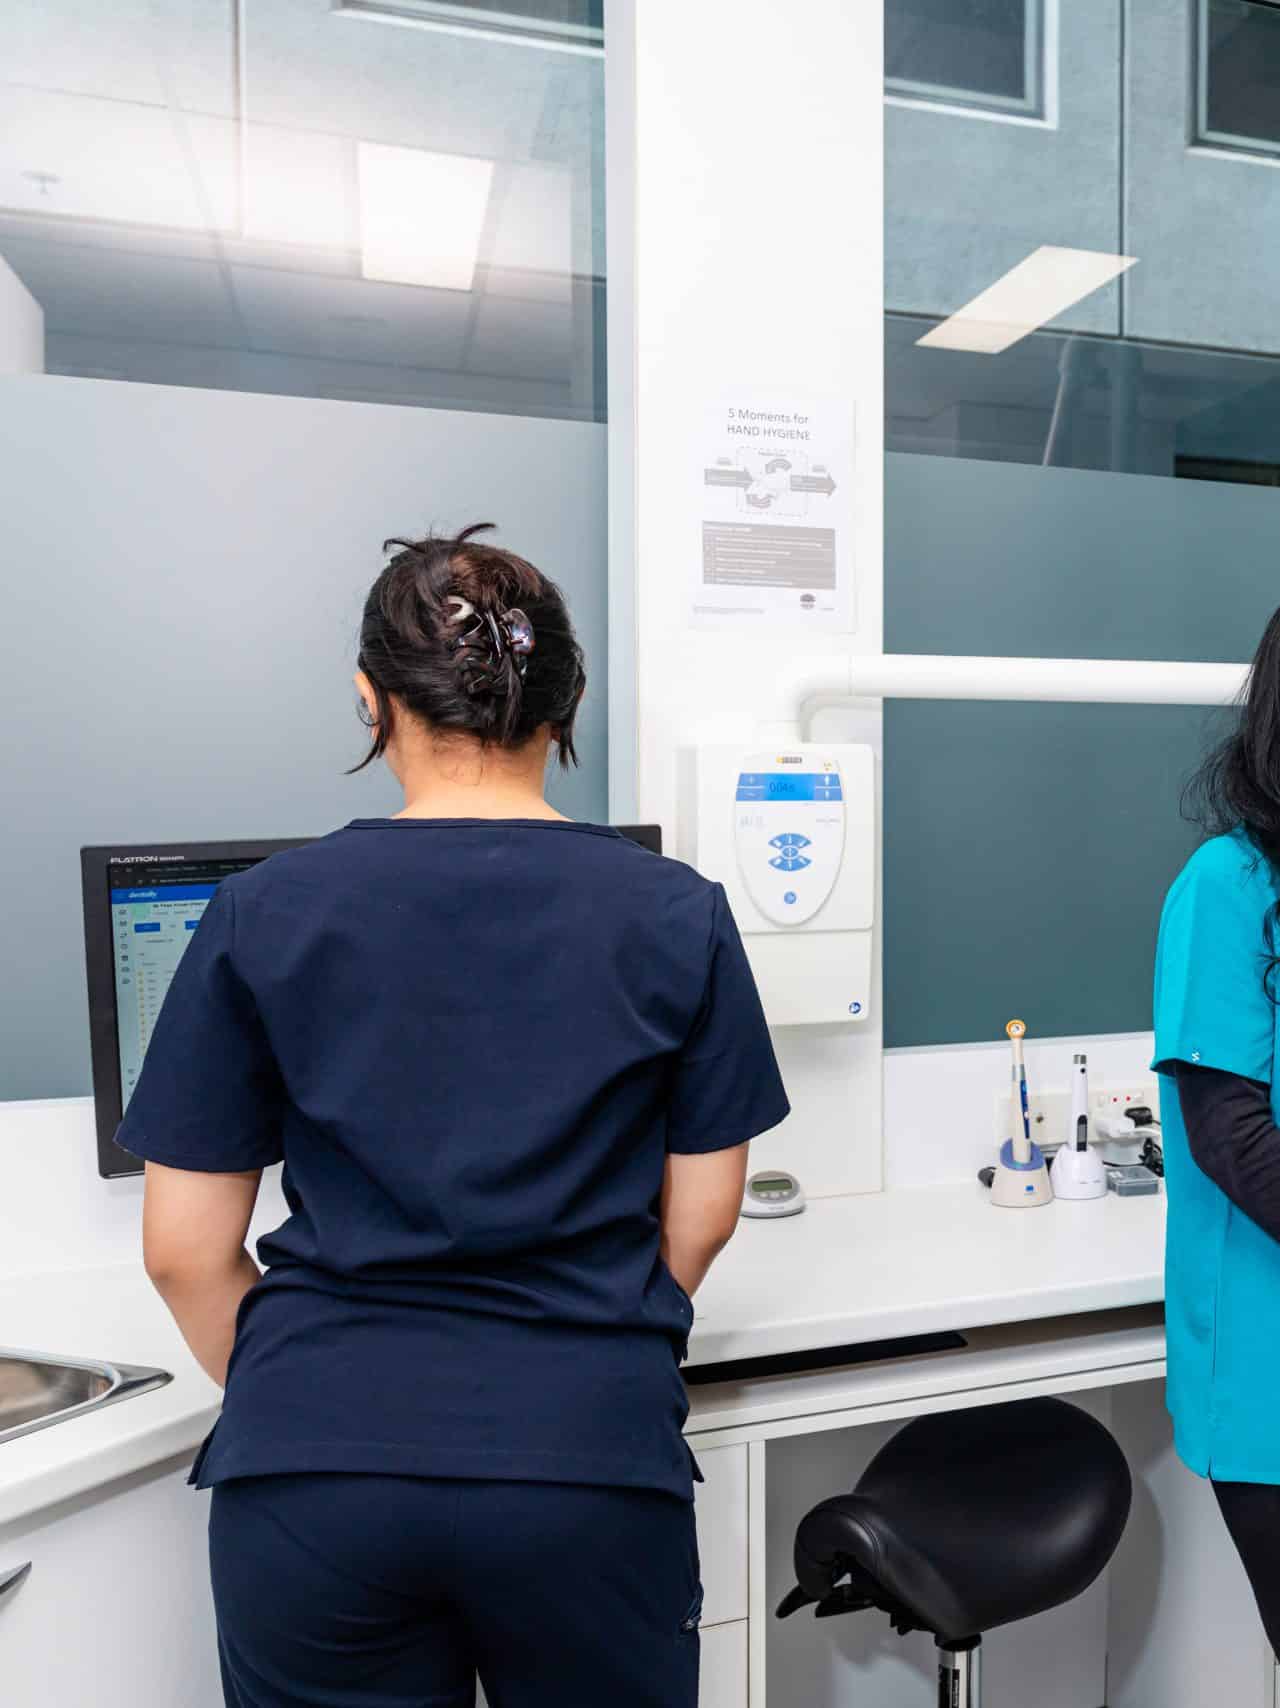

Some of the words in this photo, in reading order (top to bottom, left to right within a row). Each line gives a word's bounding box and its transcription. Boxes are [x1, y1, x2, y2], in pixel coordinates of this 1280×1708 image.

[728, 408, 735, 418] 5
[738, 409, 791, 424] Moments
[793, 413, 809, 425] for
[727, 424, 760, 436] HAND
[763, 427, 811, 441] HYGIENE
